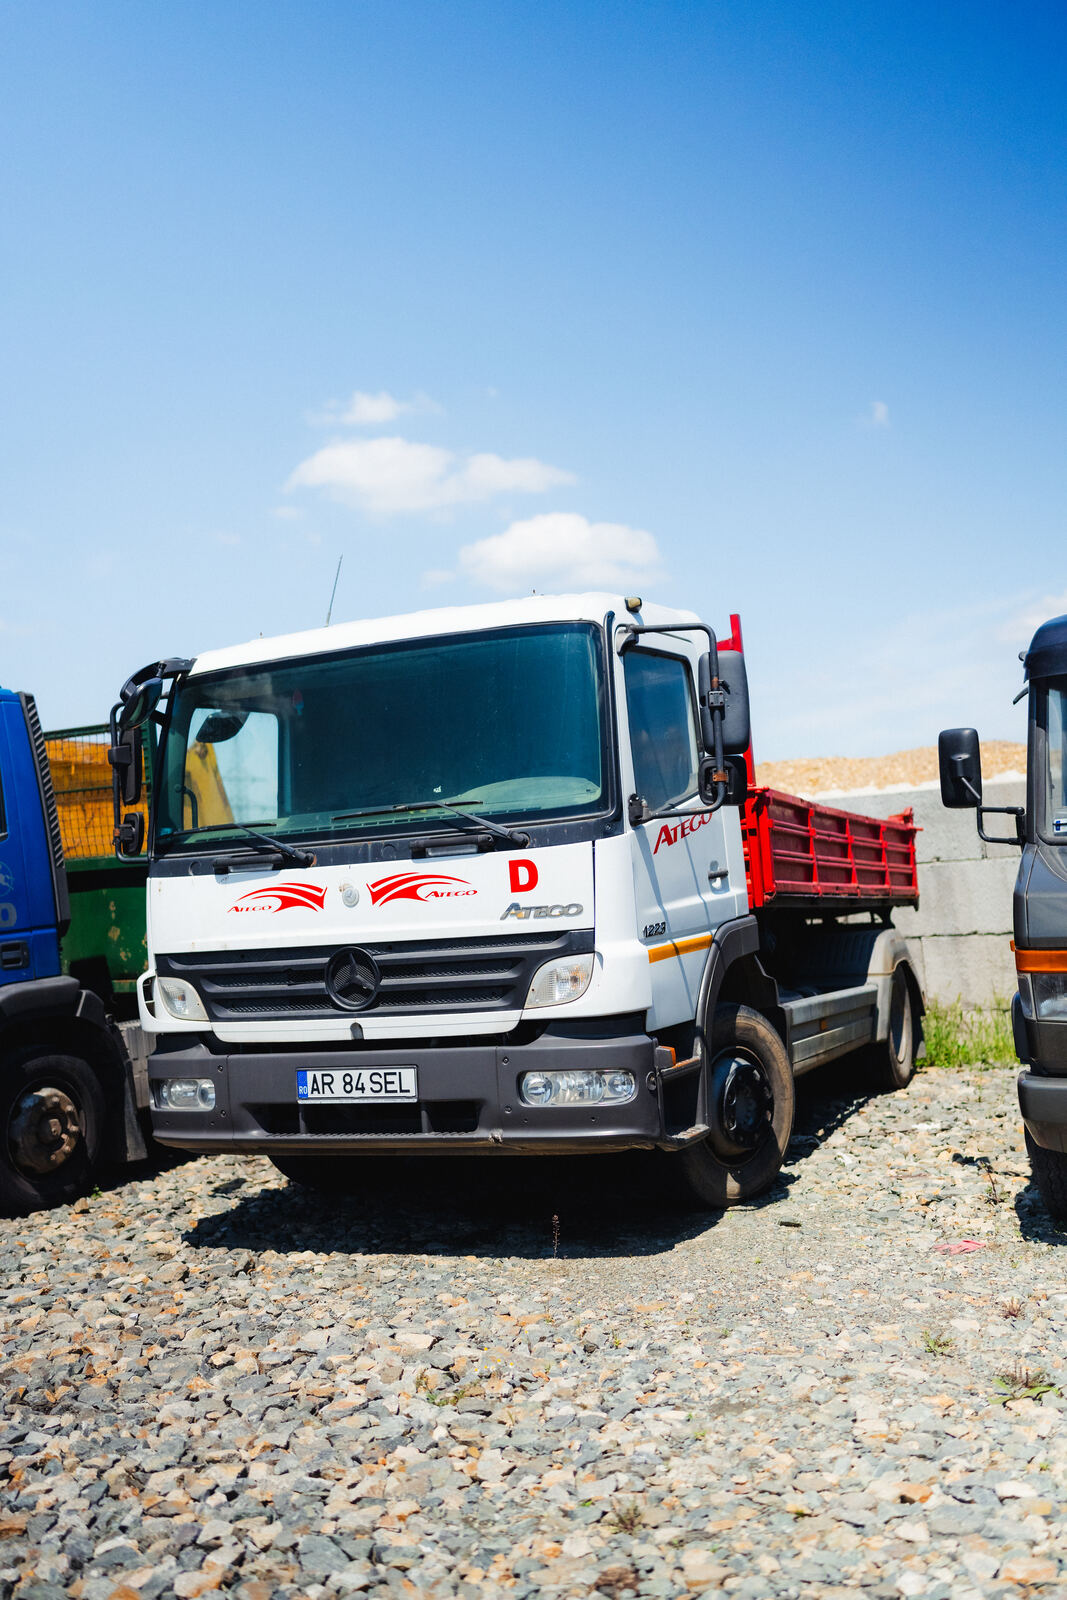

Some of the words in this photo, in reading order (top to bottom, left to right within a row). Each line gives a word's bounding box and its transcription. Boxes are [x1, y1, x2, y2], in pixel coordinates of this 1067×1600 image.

[508, 859, 539, 893] D
[500, 902, 584, 921] ATEGO
[643, 921, 666, 938] 1223
[298, 1085, 308, 1095] RO
[310, 1073, 335, 1095] AR
[342, 1072, 366, 1095] 84
[369, 1071, 411, 1094] SEL
